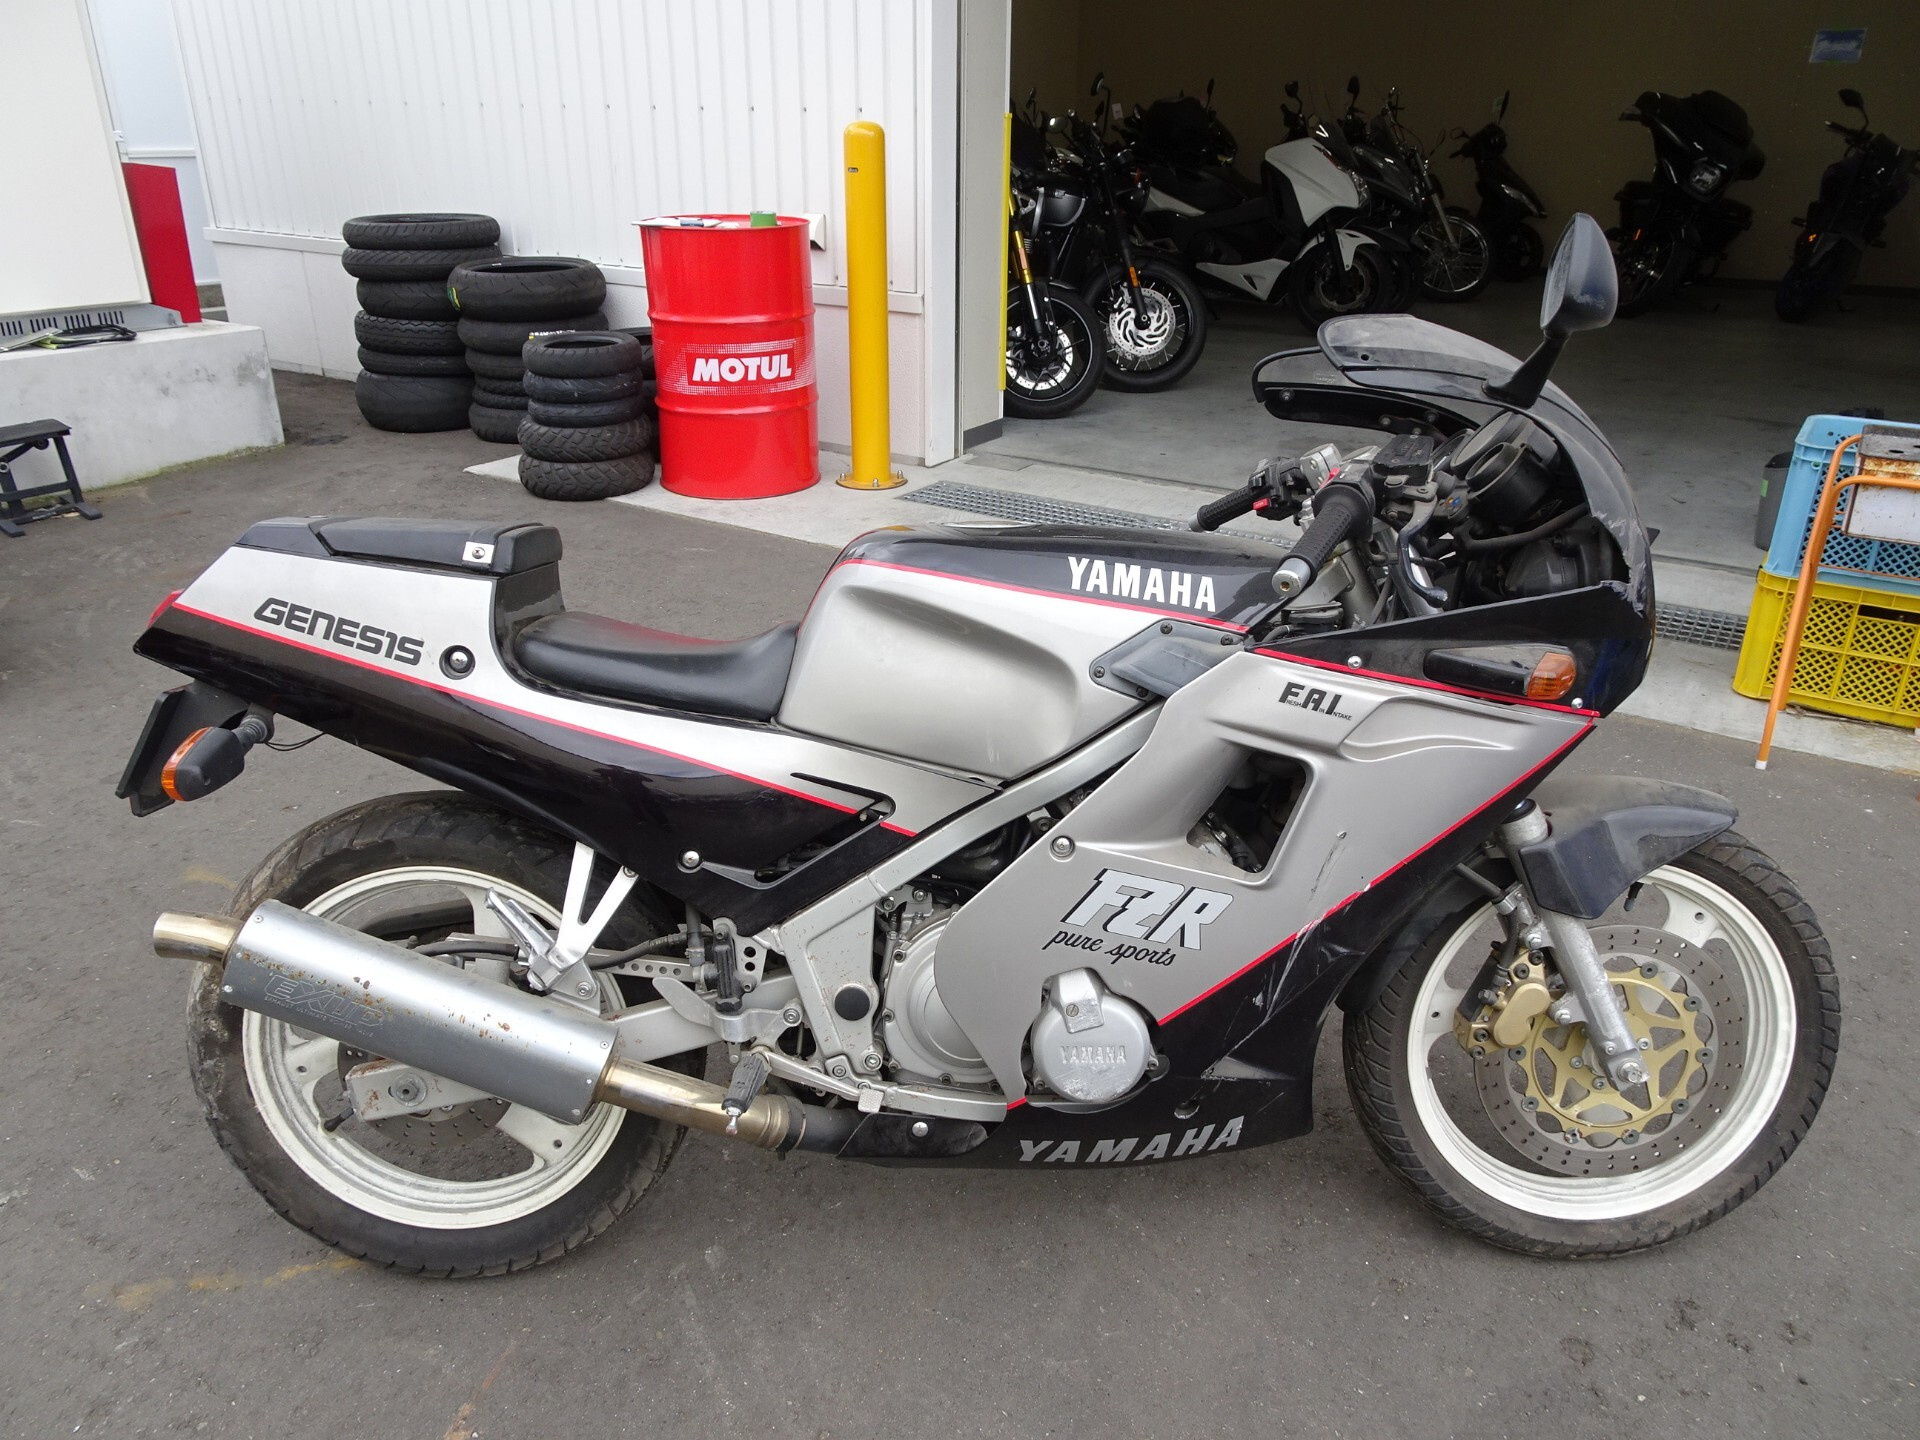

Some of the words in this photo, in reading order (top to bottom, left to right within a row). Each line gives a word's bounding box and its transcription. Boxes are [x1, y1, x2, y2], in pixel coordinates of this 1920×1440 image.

[692, 354, 792, 382] MOTUL
[1067, 556, 1216, 613] YAMAHA
[254, 597, 425, 666] GENESIS
[1060, 868, 1234, 950] FZR
[1041, 930, 1104, 952] pure
[1104, 943, 1177, 967] sports
[264, 974, 385, 1027] EXUP
[1060, 1044, 1128, 1065] YAMAHA
[1018, 1115, 1245, 1163] YAMAHA
